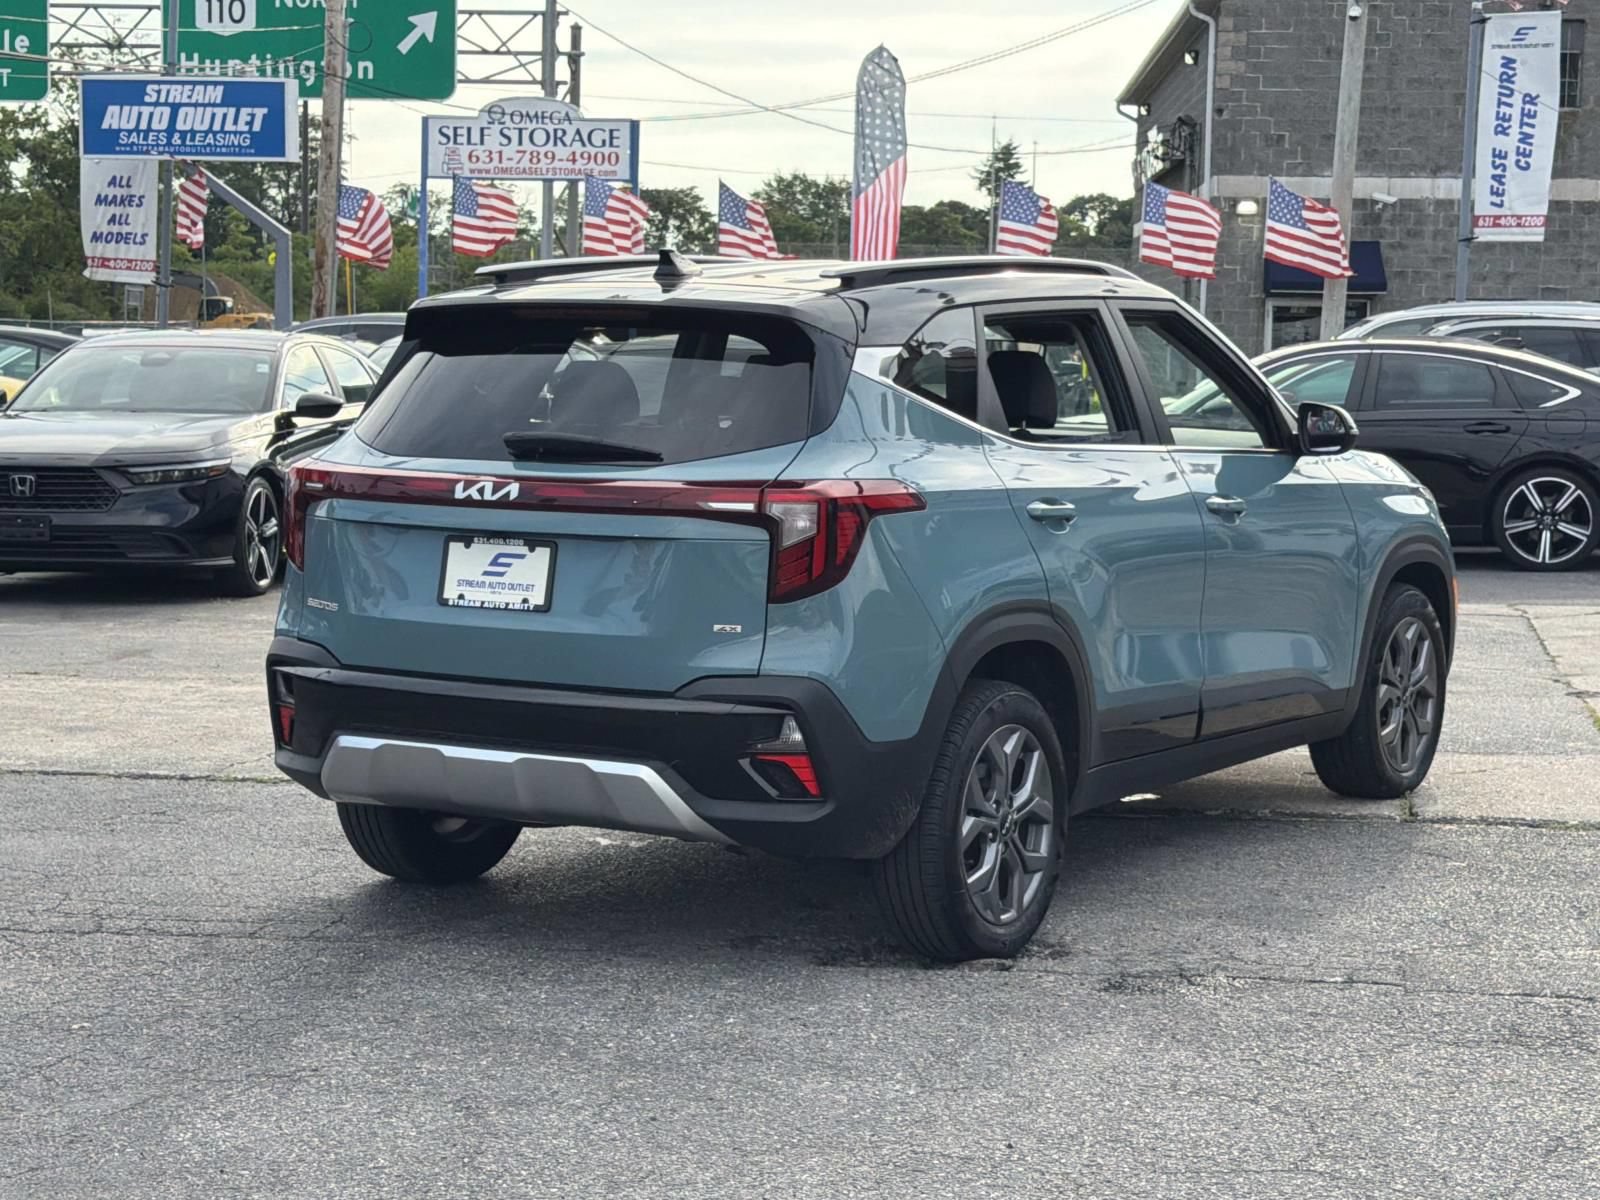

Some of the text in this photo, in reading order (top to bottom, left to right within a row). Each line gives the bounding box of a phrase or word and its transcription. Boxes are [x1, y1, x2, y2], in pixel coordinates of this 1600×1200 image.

[206, 0, 245, 24] 110
[180, 52, 374, 86] Huntingn
[144, 84, 224, 104] STREAM
[101, 105, 268, 132] AUTO OUTLET
[510, 110, 573, 125] OMEGA
[118, 131, 251, 146] SALES & LEASING
[438, 125, 620, 148] SELF STORAGE
[1489, 55, 1518, 209] LEASE RETURN
[1514, 92, 1541, 172] CENTER
[467, 149, 620, 167] 631-789-4900
[107, 175, 133, 189] ALL
[94, 193, 145, 208] MAKES
[106, 213, 132, 226] ALL
[89, 231, 149, 246] MODELS
[454, 480, 520, 501] KIA
[456, 579, 536, 593] STREAM AUTO OUTLET
[447, 598, 536, 611] STREAM AUTO AMITY
